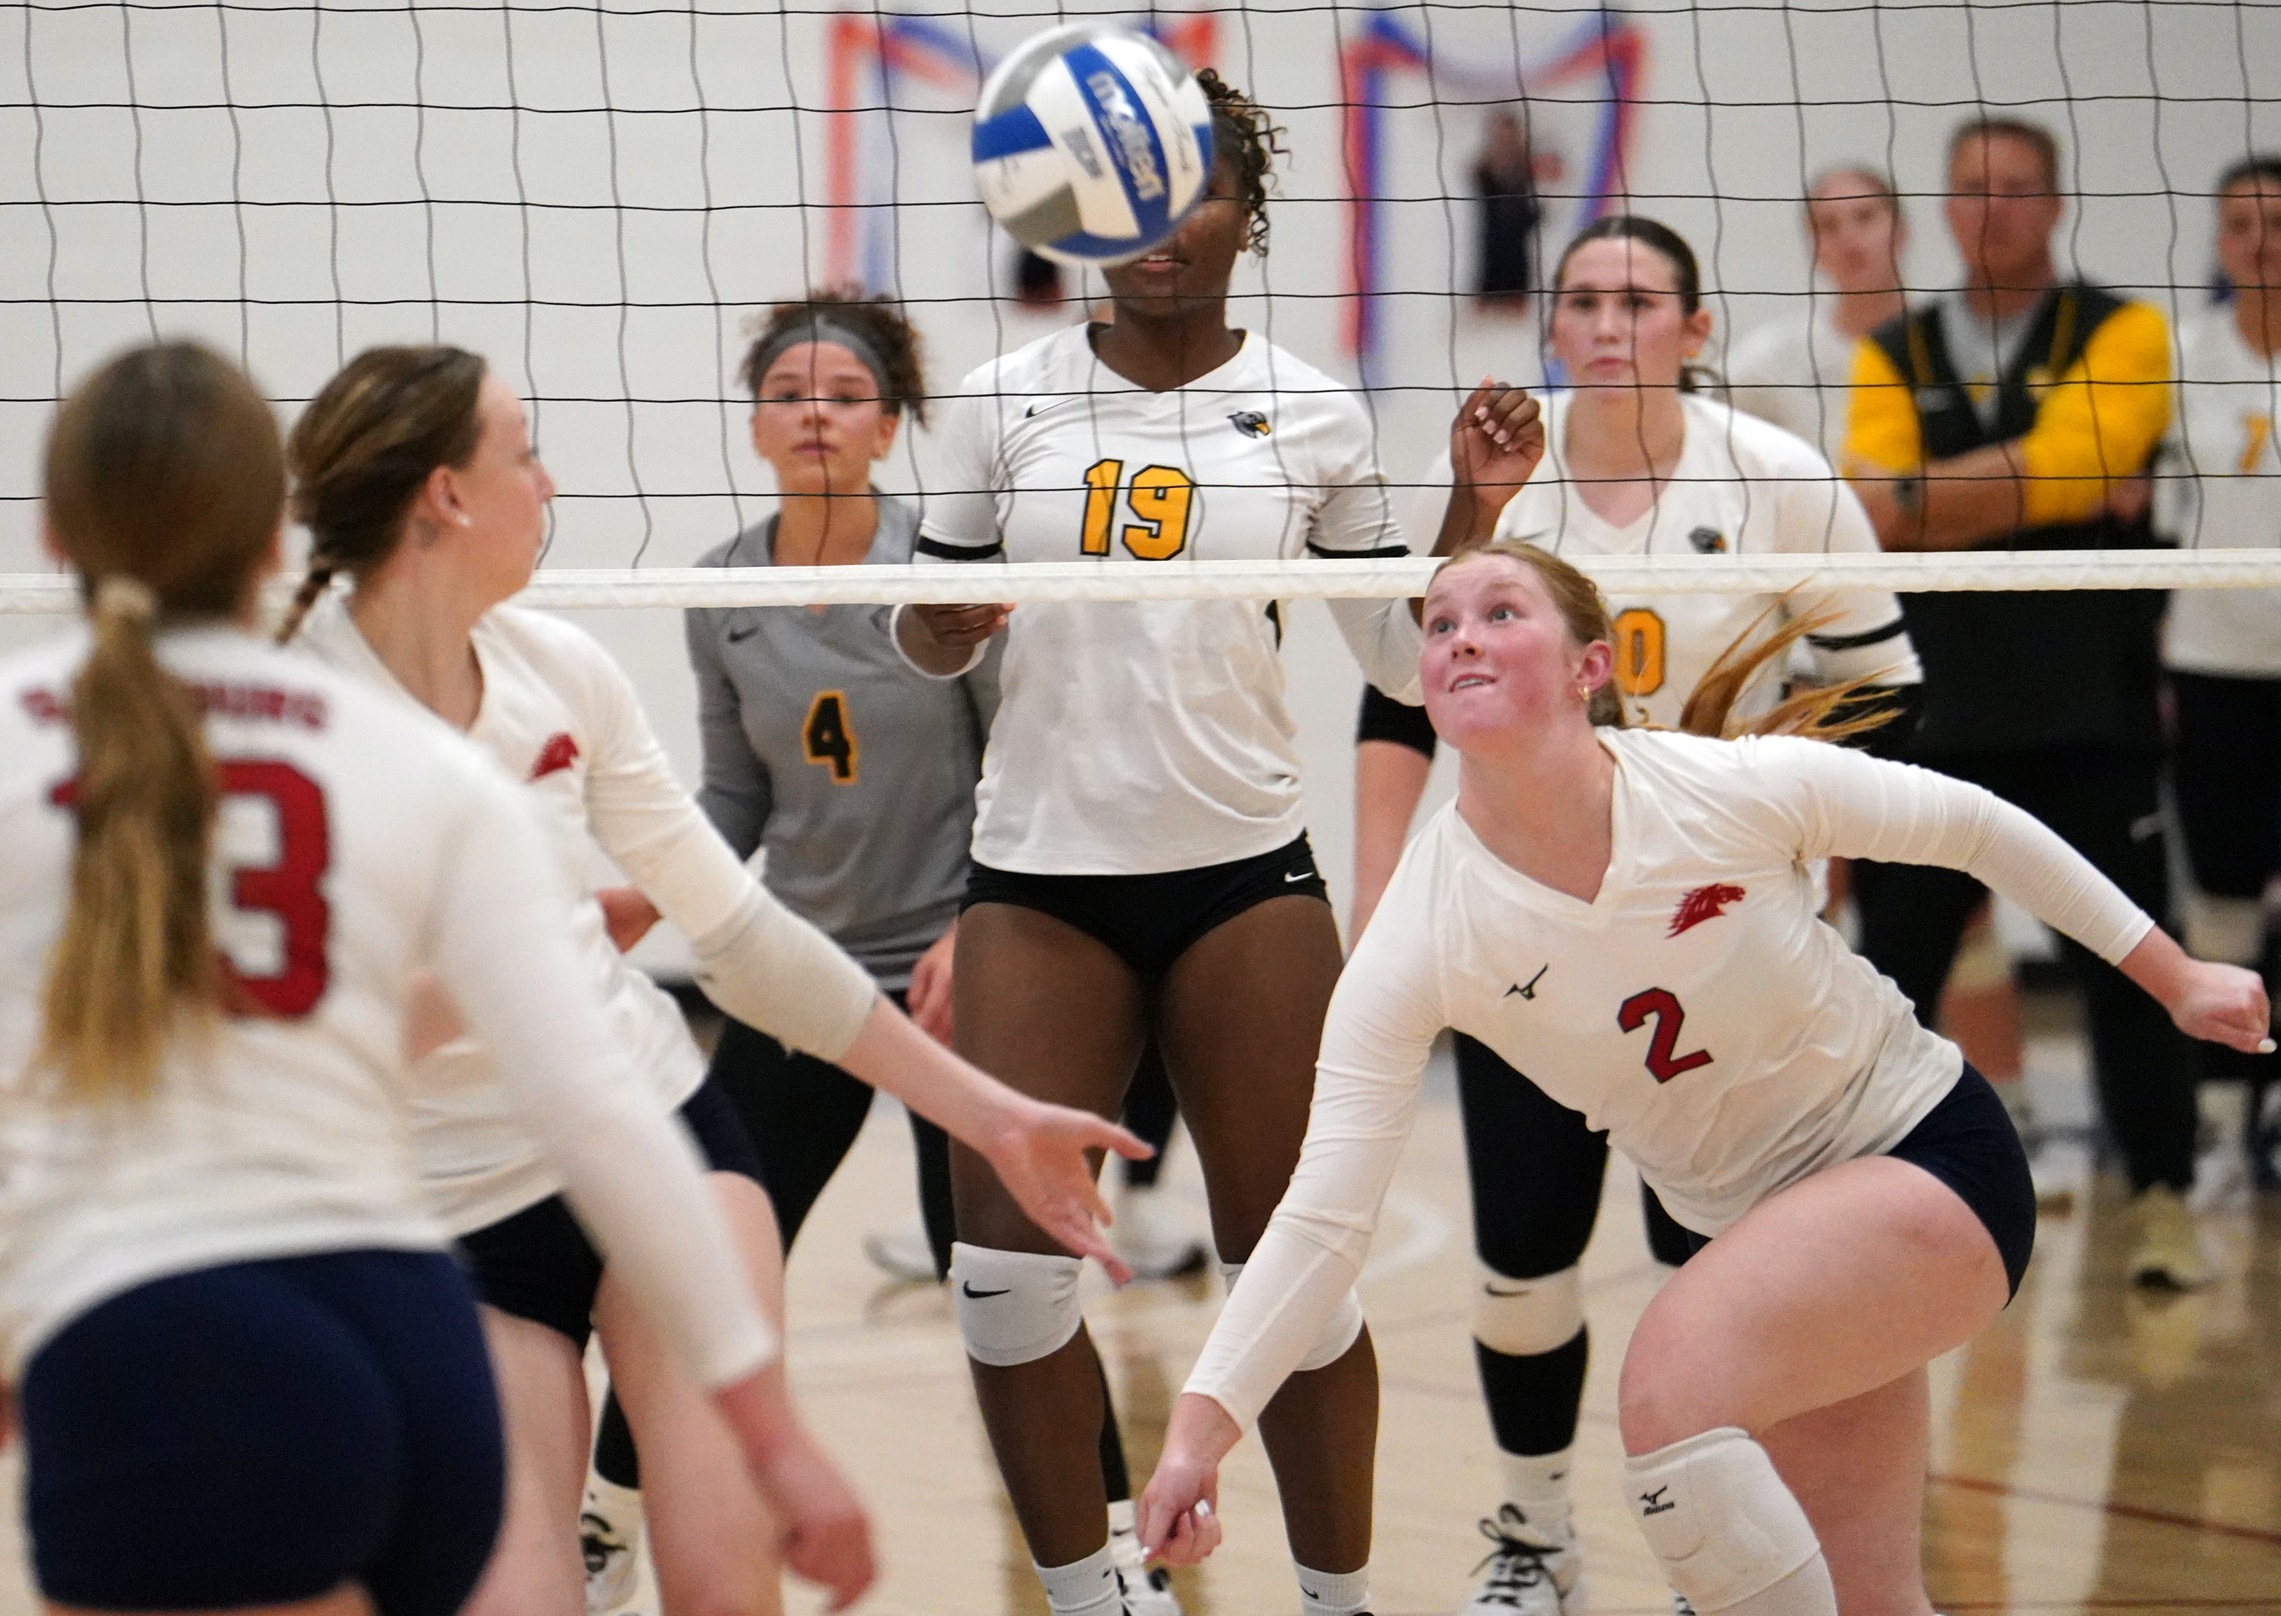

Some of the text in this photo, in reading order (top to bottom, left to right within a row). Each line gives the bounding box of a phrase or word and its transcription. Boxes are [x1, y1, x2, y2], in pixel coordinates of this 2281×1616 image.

[1080, 458, 1194, 560] 19
[802, 689, 859, 785] 4
[1617, 986, 1714, 1084] 2
